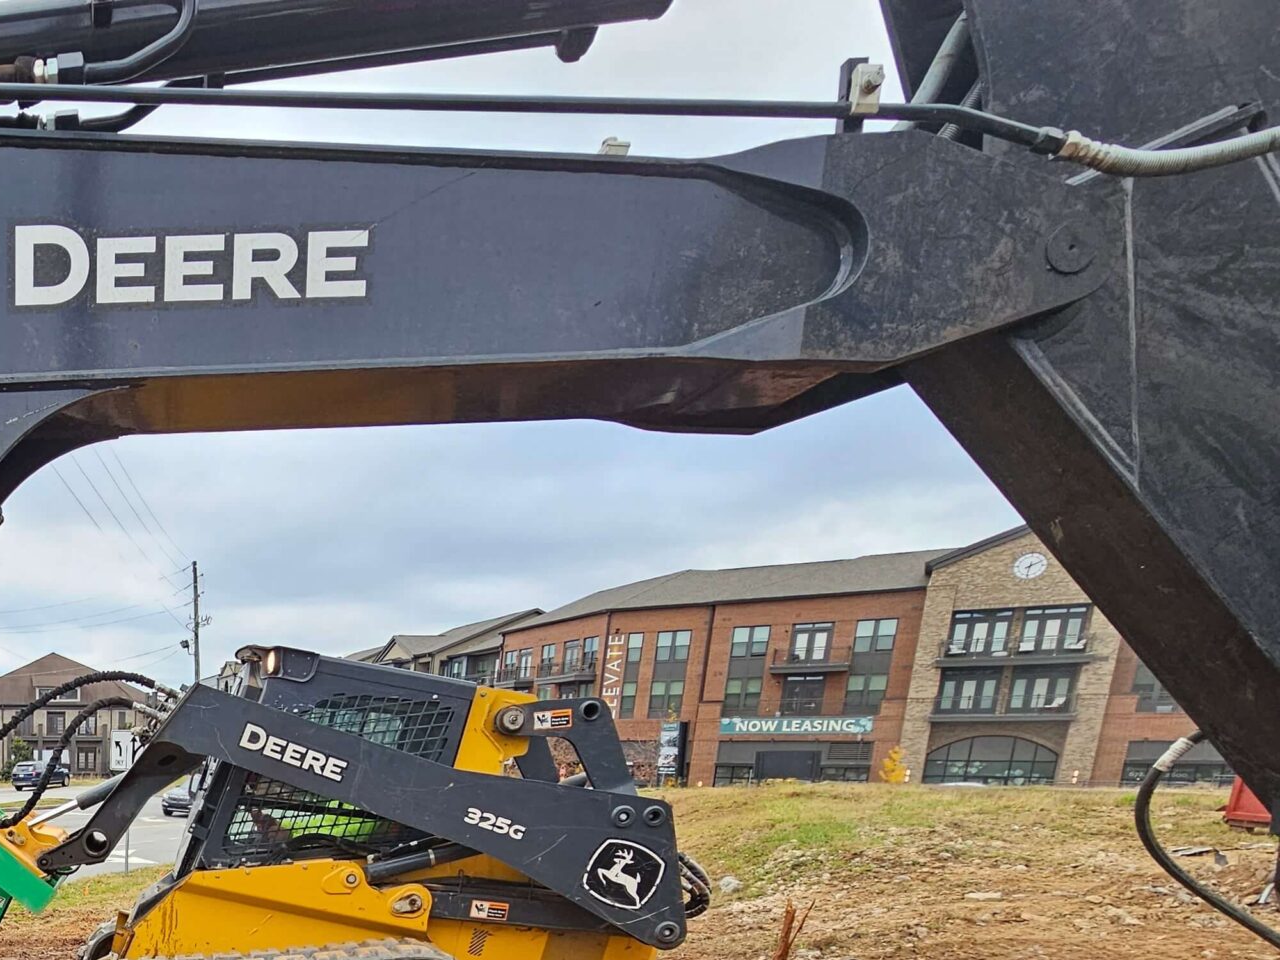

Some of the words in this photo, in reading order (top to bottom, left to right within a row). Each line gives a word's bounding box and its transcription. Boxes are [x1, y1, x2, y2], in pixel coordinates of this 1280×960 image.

[15, 224, 369, 306] DEERE
[735, 719, 778, 732] NOW
[781, 719, 856, 732] LEASING
[239, 722, 348, 781] DEERE
[464, 807, 526, 840] 325G
